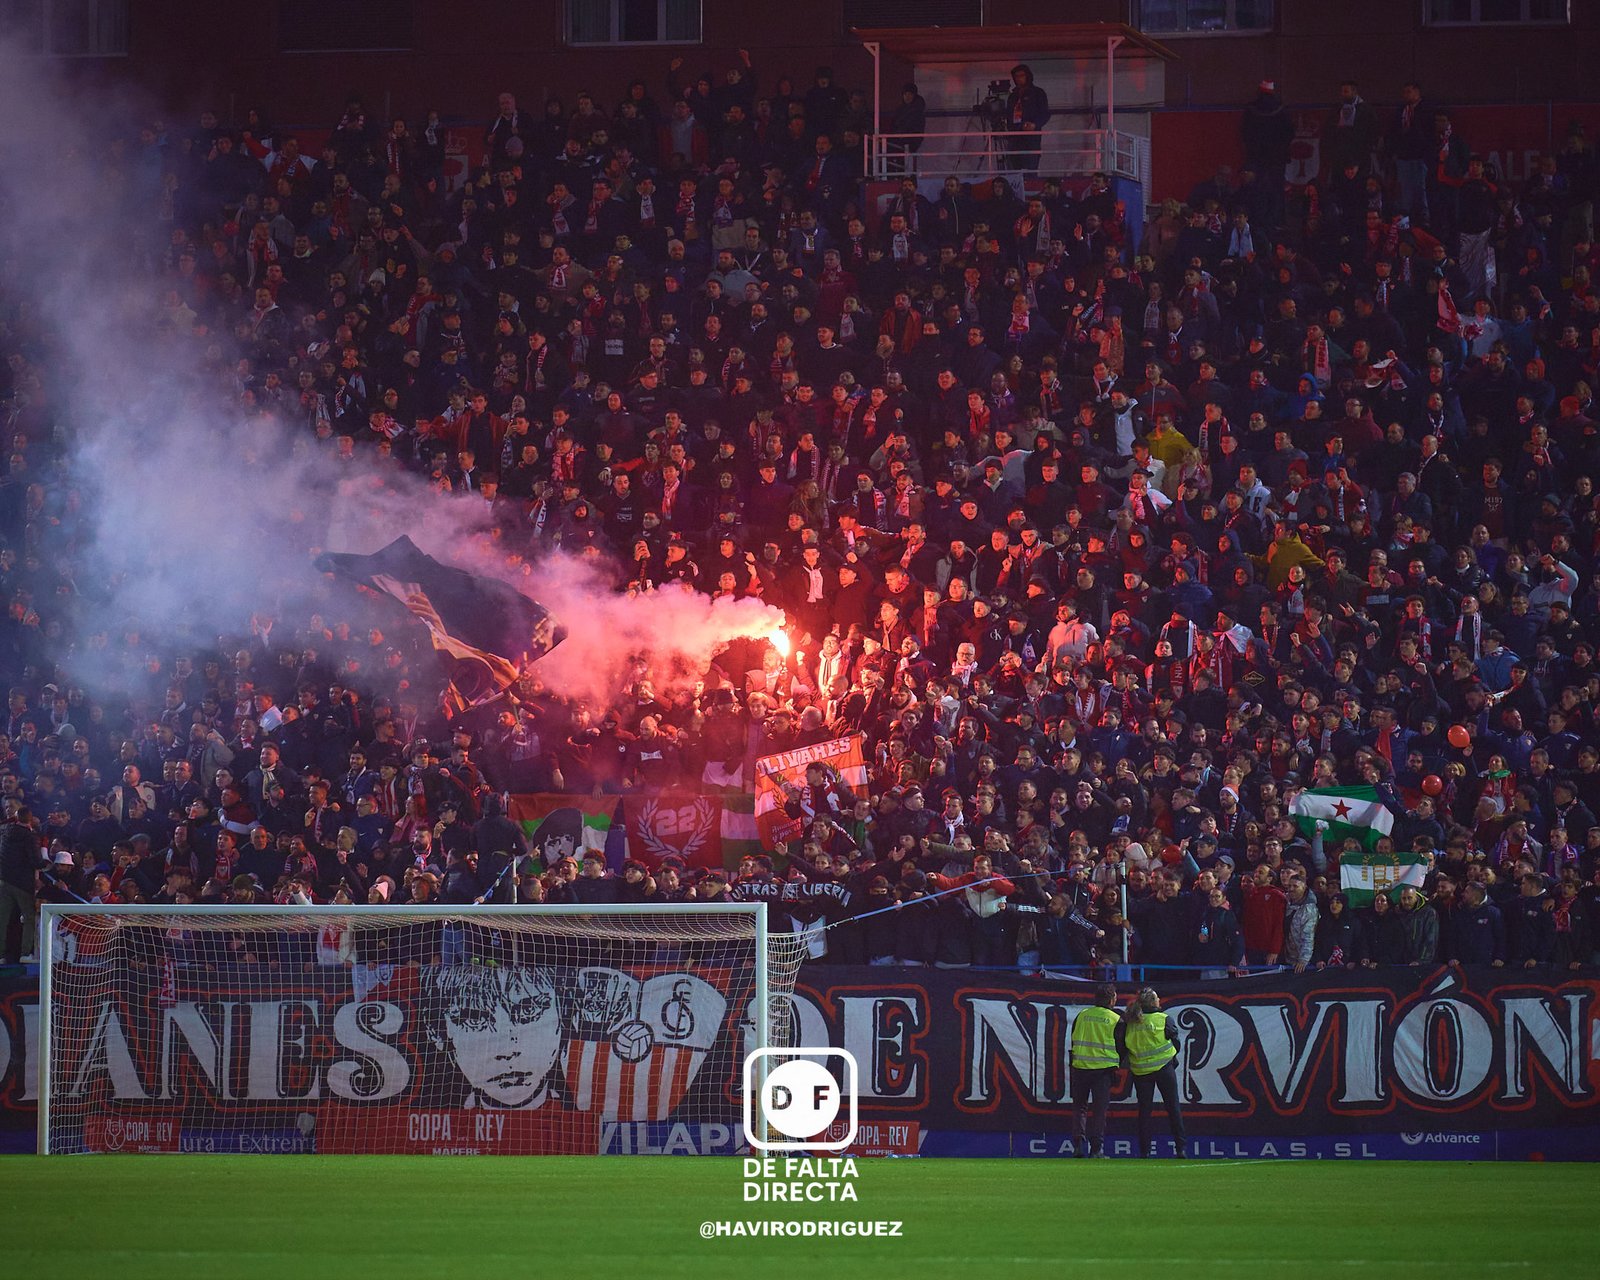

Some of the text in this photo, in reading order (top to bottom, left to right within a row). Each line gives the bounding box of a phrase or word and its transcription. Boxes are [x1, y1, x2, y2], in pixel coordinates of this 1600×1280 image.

[656, 805, 697, 836] 22
[0, 1000, 412, 1103] IANES
[964, 975, 1588, 1104] NRVIÓN
[409, 1113, 505, 1141] COPA REY
[888, 1125, 909, 1146] REY
[1424, 1132, 1480, 1143] Advance
